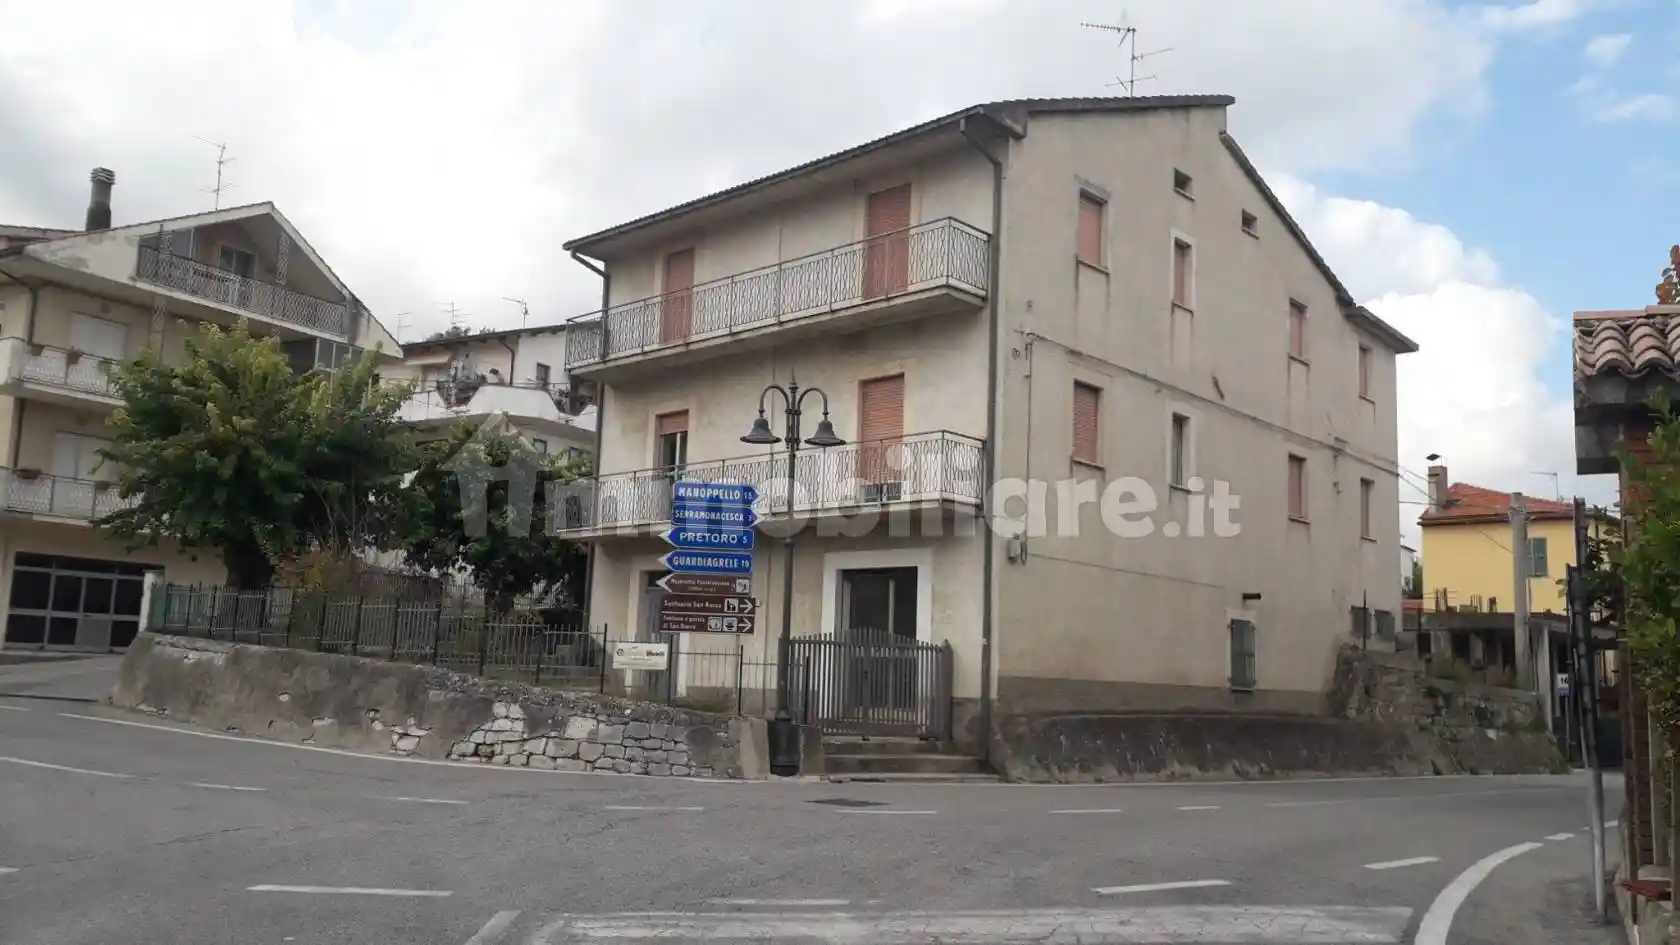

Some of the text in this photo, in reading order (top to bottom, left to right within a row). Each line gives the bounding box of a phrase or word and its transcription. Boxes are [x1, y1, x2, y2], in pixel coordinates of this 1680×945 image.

[678, 486, 741, 500] MANOPPELLO
[675, 509, 744, 522] SERRAMONACESCA
[679, 532, 738, 544] PRETORO
[672, 555, 739, 568] GUARDIAGRELE
